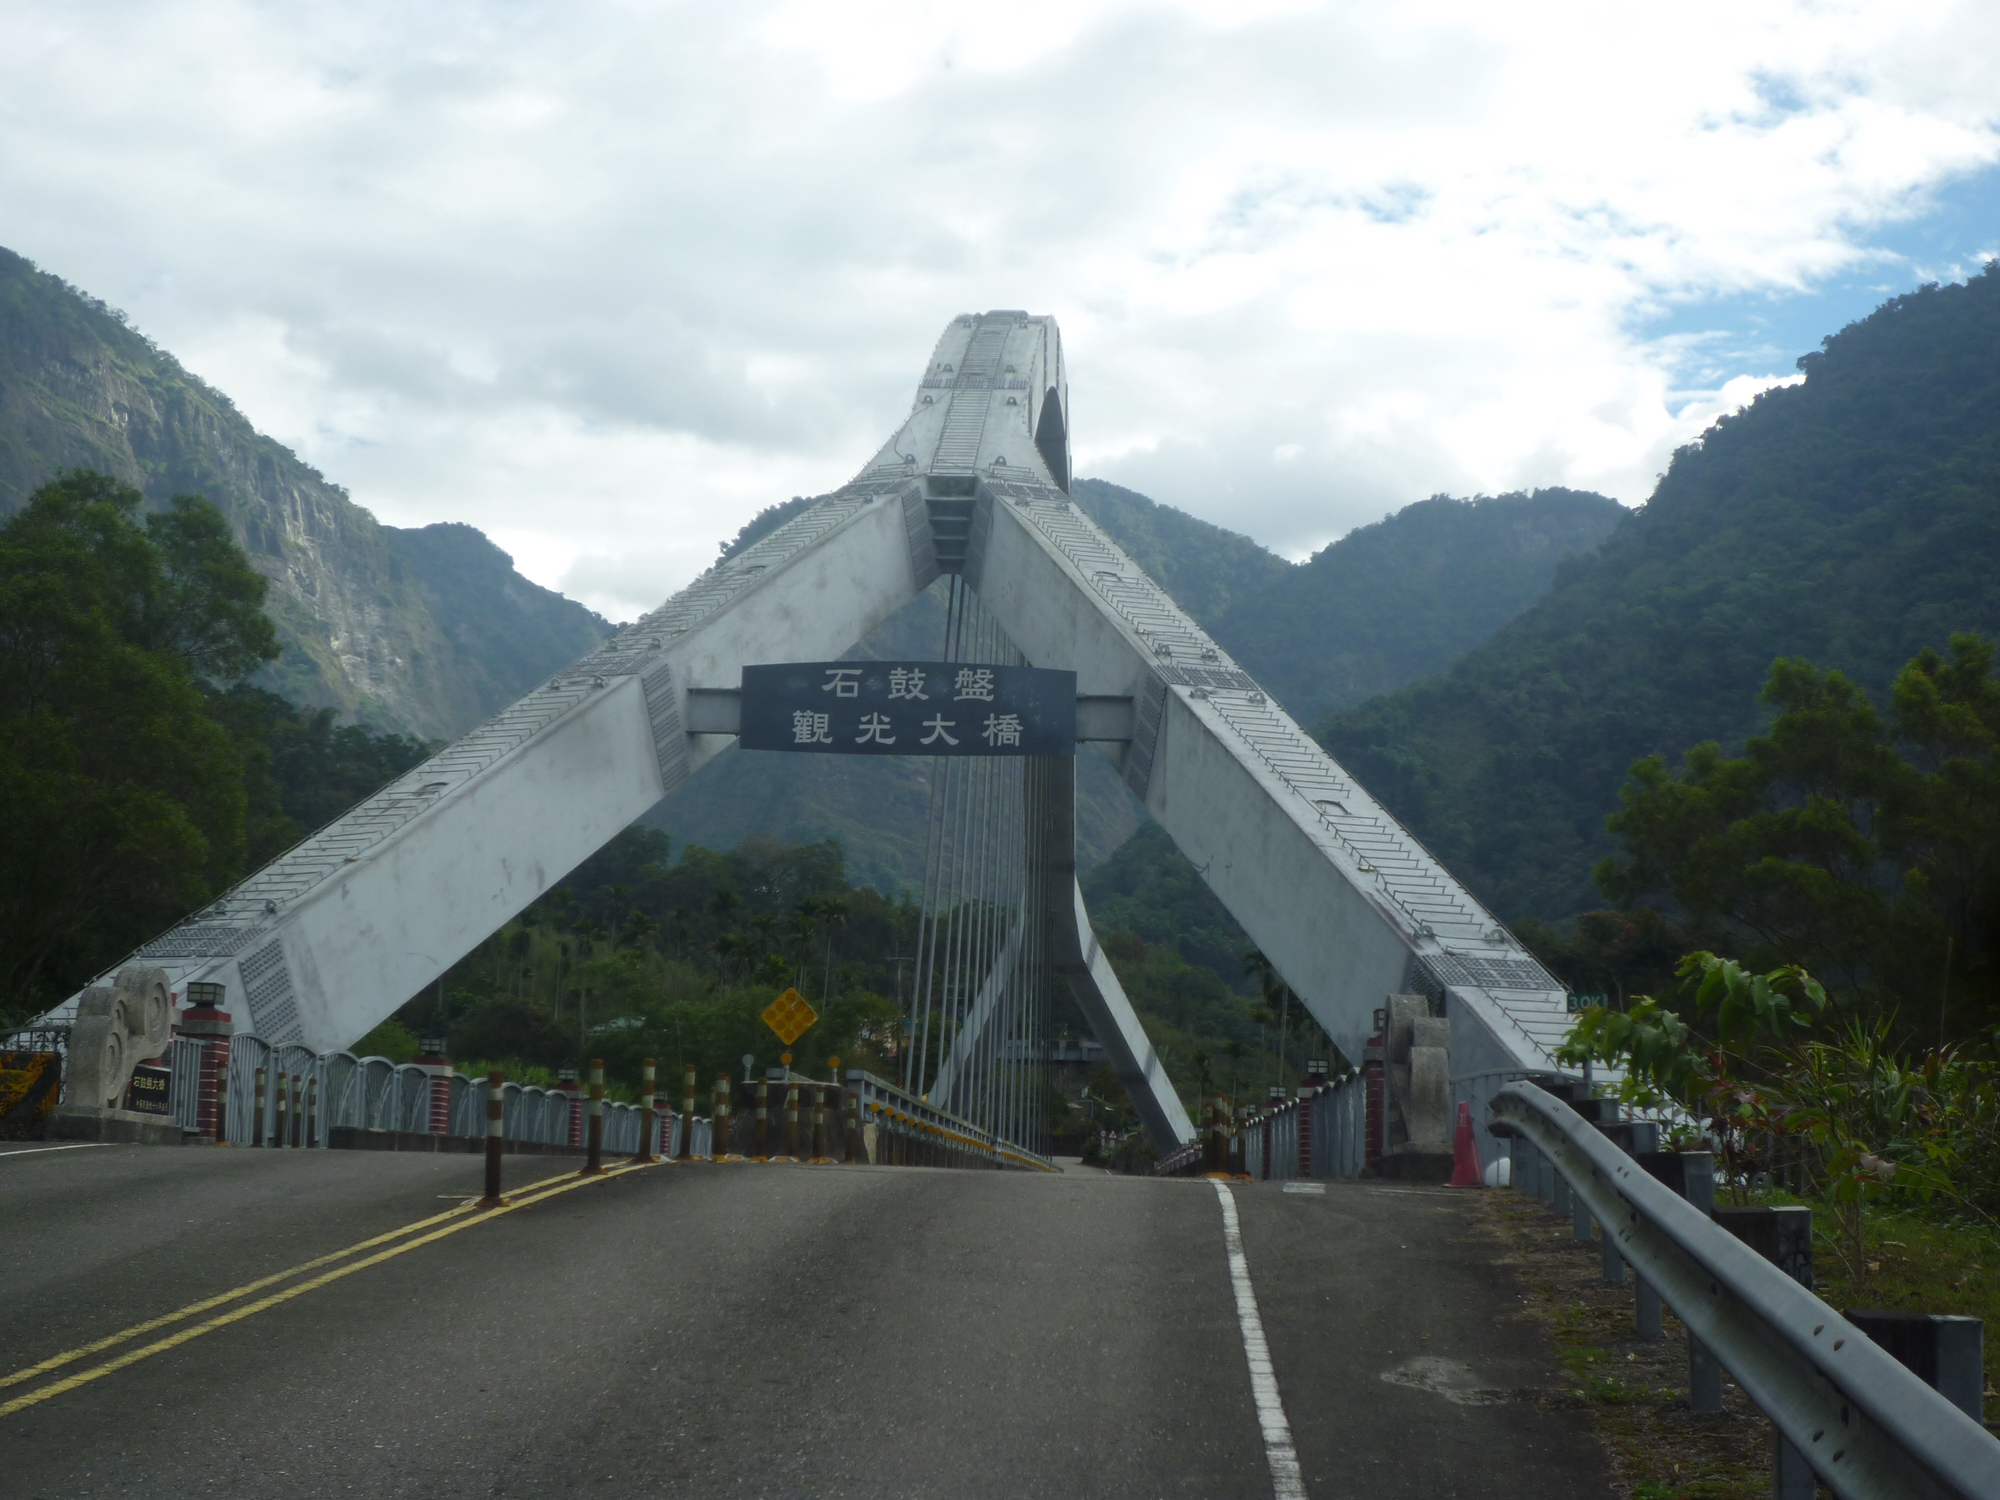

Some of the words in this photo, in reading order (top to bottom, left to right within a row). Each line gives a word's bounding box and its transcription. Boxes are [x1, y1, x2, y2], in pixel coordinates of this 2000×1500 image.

[821, 667, 995, 702] 石鼓盤
[791, 710, 1025, 747] 觀光大橋
